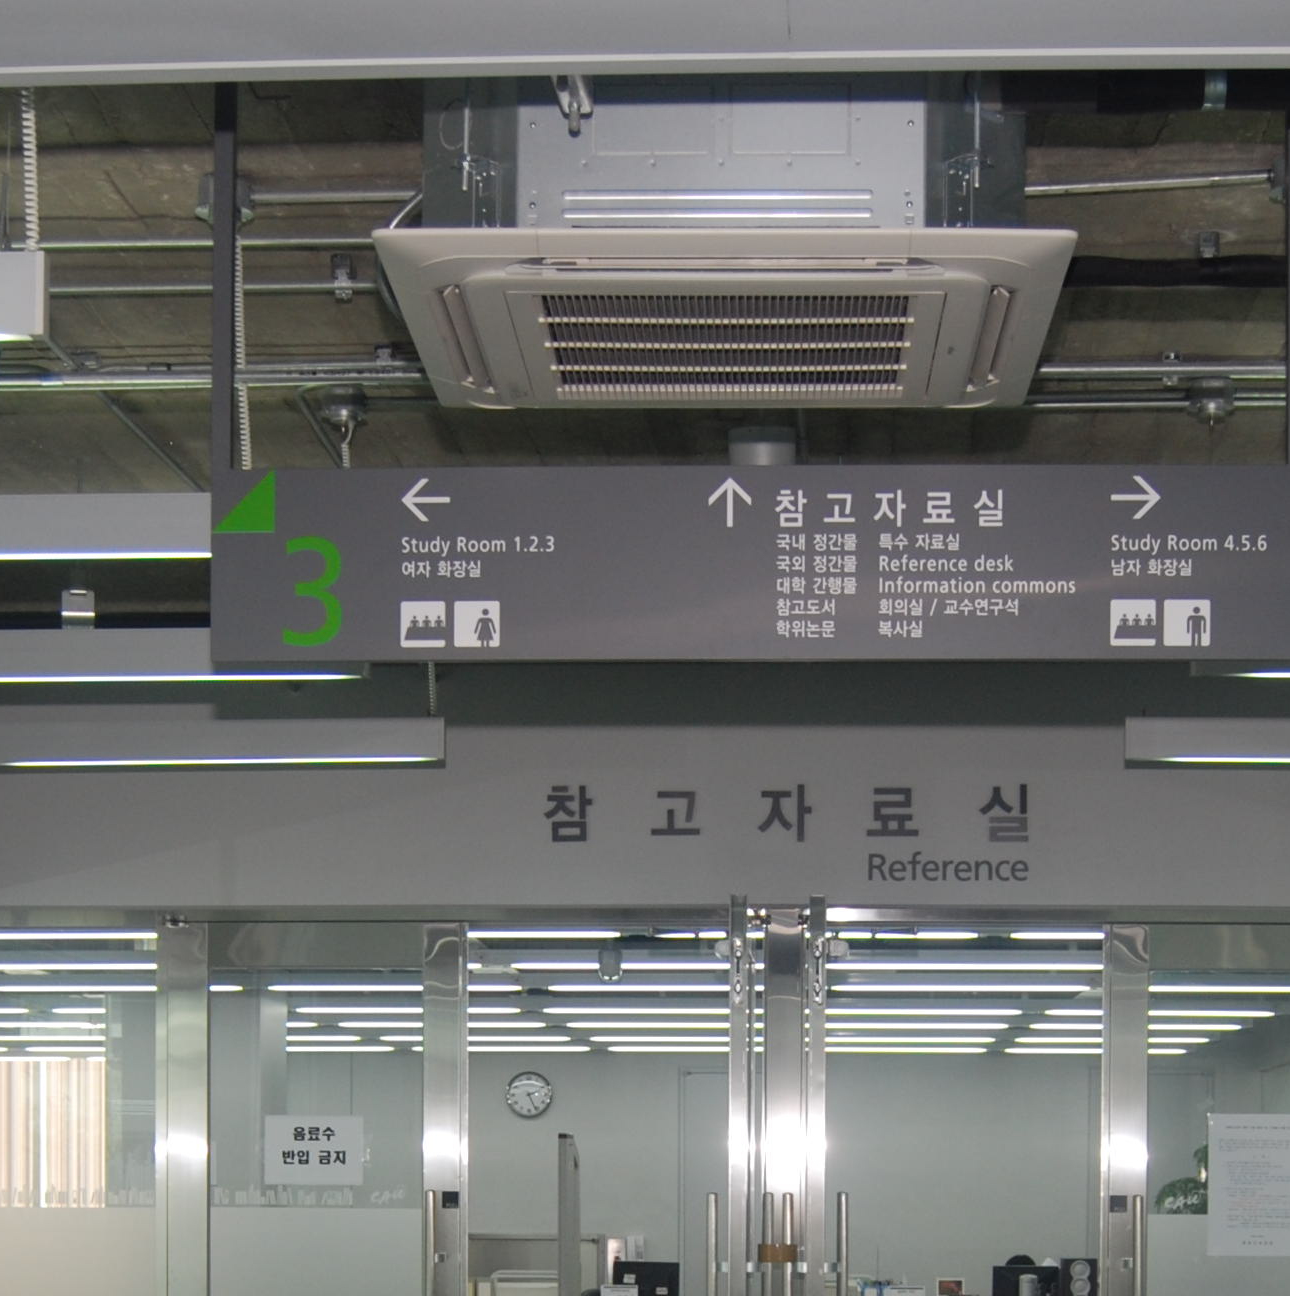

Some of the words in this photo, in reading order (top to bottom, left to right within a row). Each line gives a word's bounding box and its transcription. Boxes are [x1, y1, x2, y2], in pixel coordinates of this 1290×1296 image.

[401, 535, 451, 558] Study
[456, 536, 506, 553] Room
[514, 535, 555, 553] 1.2.3
[776, 533, 806, 552] 국내
[813, 533, 858, 552] 정간물
[878, 533, 909, 551] 특수
[914, 532, 960, 551] 자료실
[1110, 533, 1161, 556] Study
[1167, 534, 1218, 552] Room
[1223, 534, 1268, 552] 4.5.6
[401, 560, 432, 579] 여자
[436, 559, 481, 579] 화장실
[775, 555, 806, 573] 국외
[812, 554, 858, 574] 정간물
[879, 553, 968, 572] Reference
[974, 554, 1014, 572] desk
[1111, 558, 1142, 577] 남자
[1146, 558, 1192, 577] 화장실
[282, 535, 343, 647] 3
[776, 576, 807, 595] 대학
[812, 576, 858, 595] 간행물
[878, 575, 986, 594] Information
[992, 580, 1076, 594] commons
[776, 598, 836, 617] 참고도서
[878, 598, 923, 617] 회의실
[776, 619, 836, 638] 학위논문
[878, 619, 923, 638] 복사실
[867, 850, 1030, 882] Reference
[292, 1126, 336, 1142] 음료수
[281, 1149, 310, 1165] 반입
[318, 1150, 347, 1166] 금지
